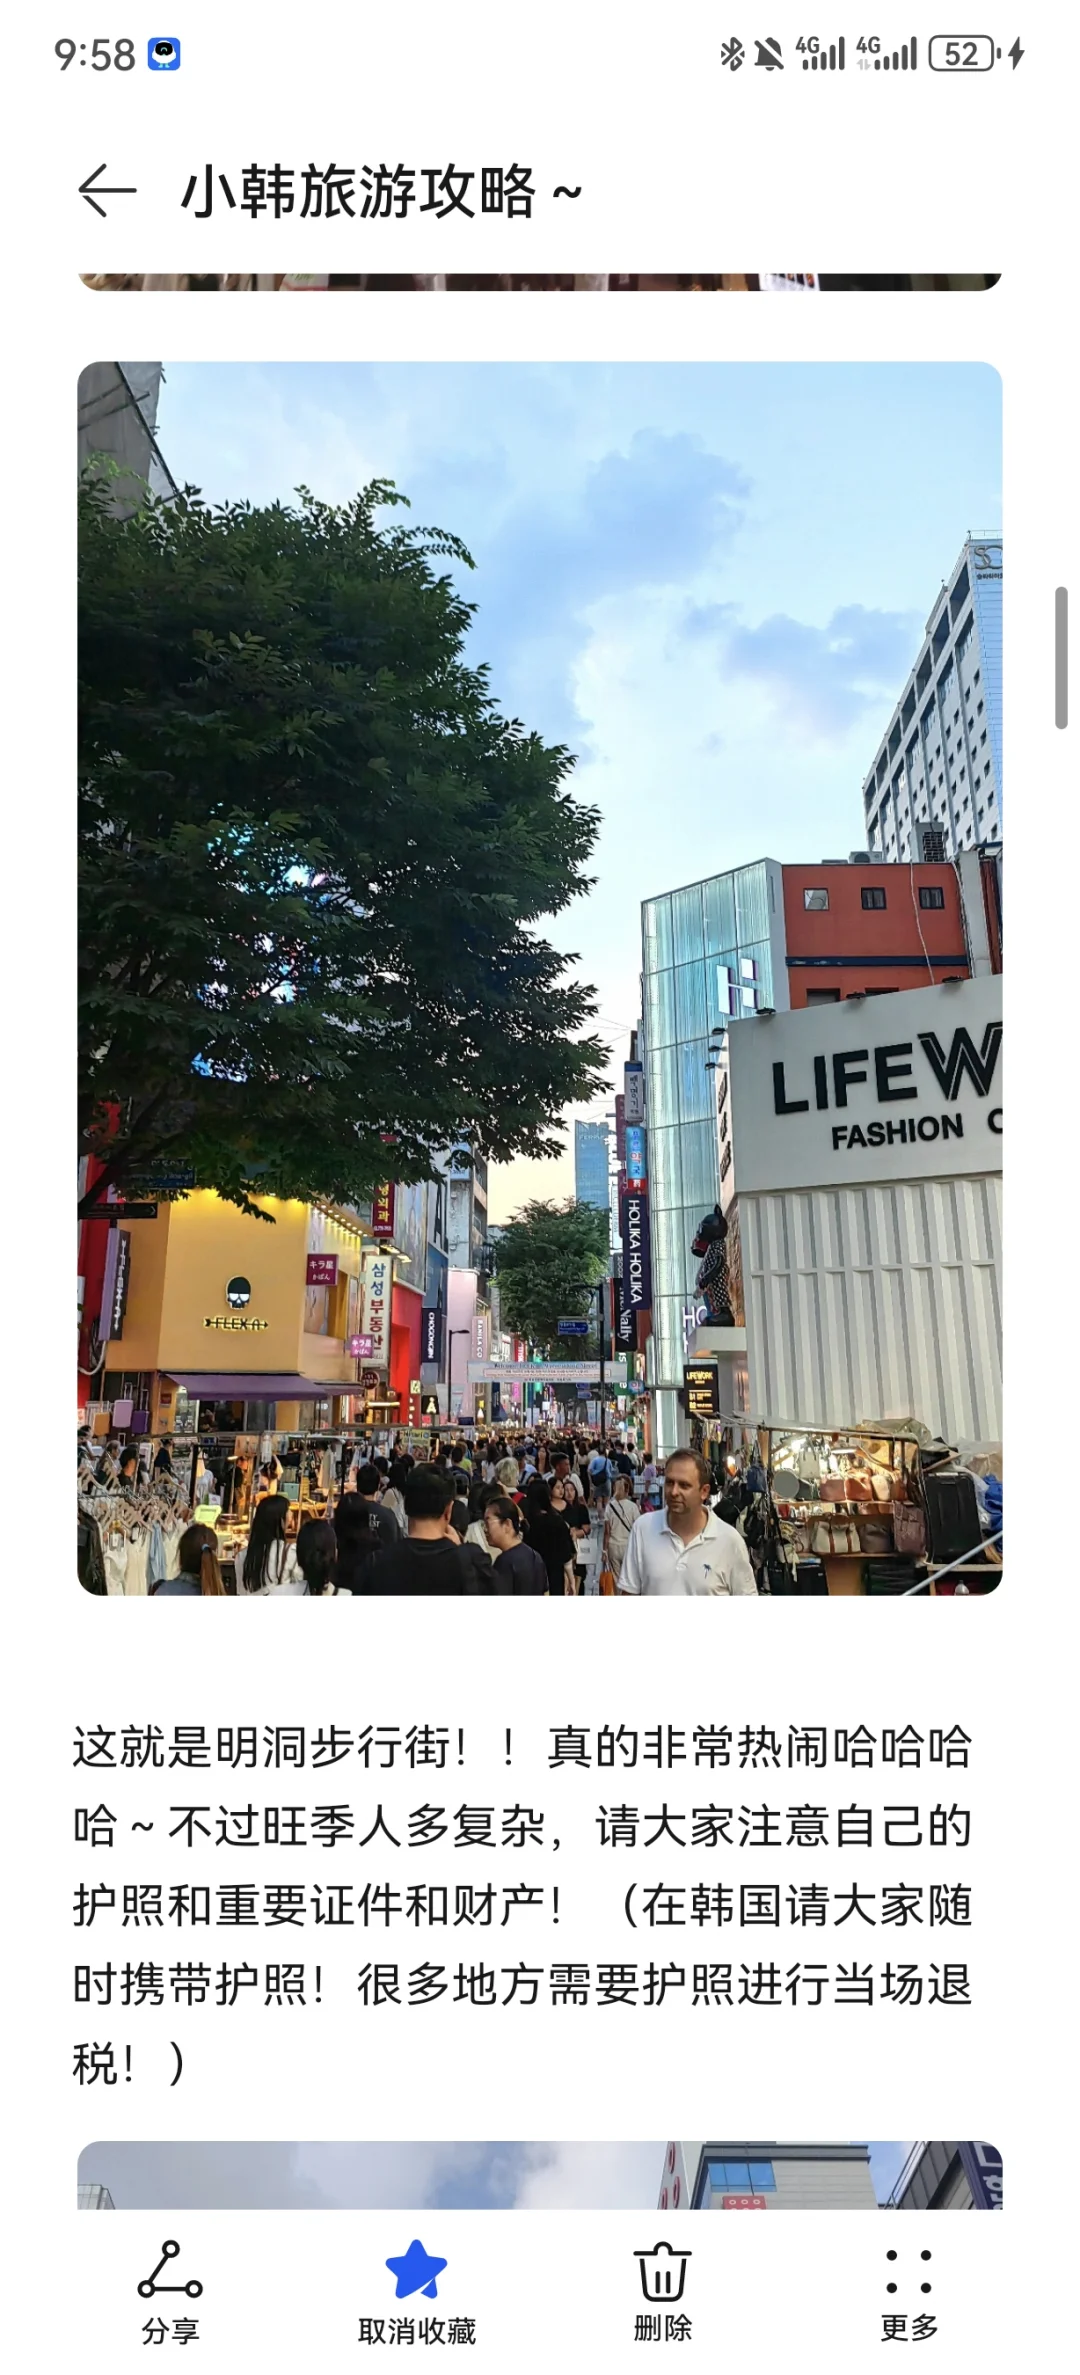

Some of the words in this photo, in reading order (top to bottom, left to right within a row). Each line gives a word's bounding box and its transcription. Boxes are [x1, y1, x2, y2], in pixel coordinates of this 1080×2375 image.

[55, 39, 135, 71] 9:58
[796, 37, 820, 54] 4G
[857, 37, 881, 54] 4G
[945, 42, 979, 66] 52
[832, 1113, 963, 1151] FASHION
[628, 1199, 641, 1249] HOLIKA
[629, 1252, 643, 1304] HOLIKA
[686, 1371, 713, 1381] LIFEWORK
[140, 2317, 201, 2345] 分享
[358, 2317, 476, 2345] 取消收藏
[634, 2314, 692, 2341] 删除
[881, 2314, 937, 2342] 更多
